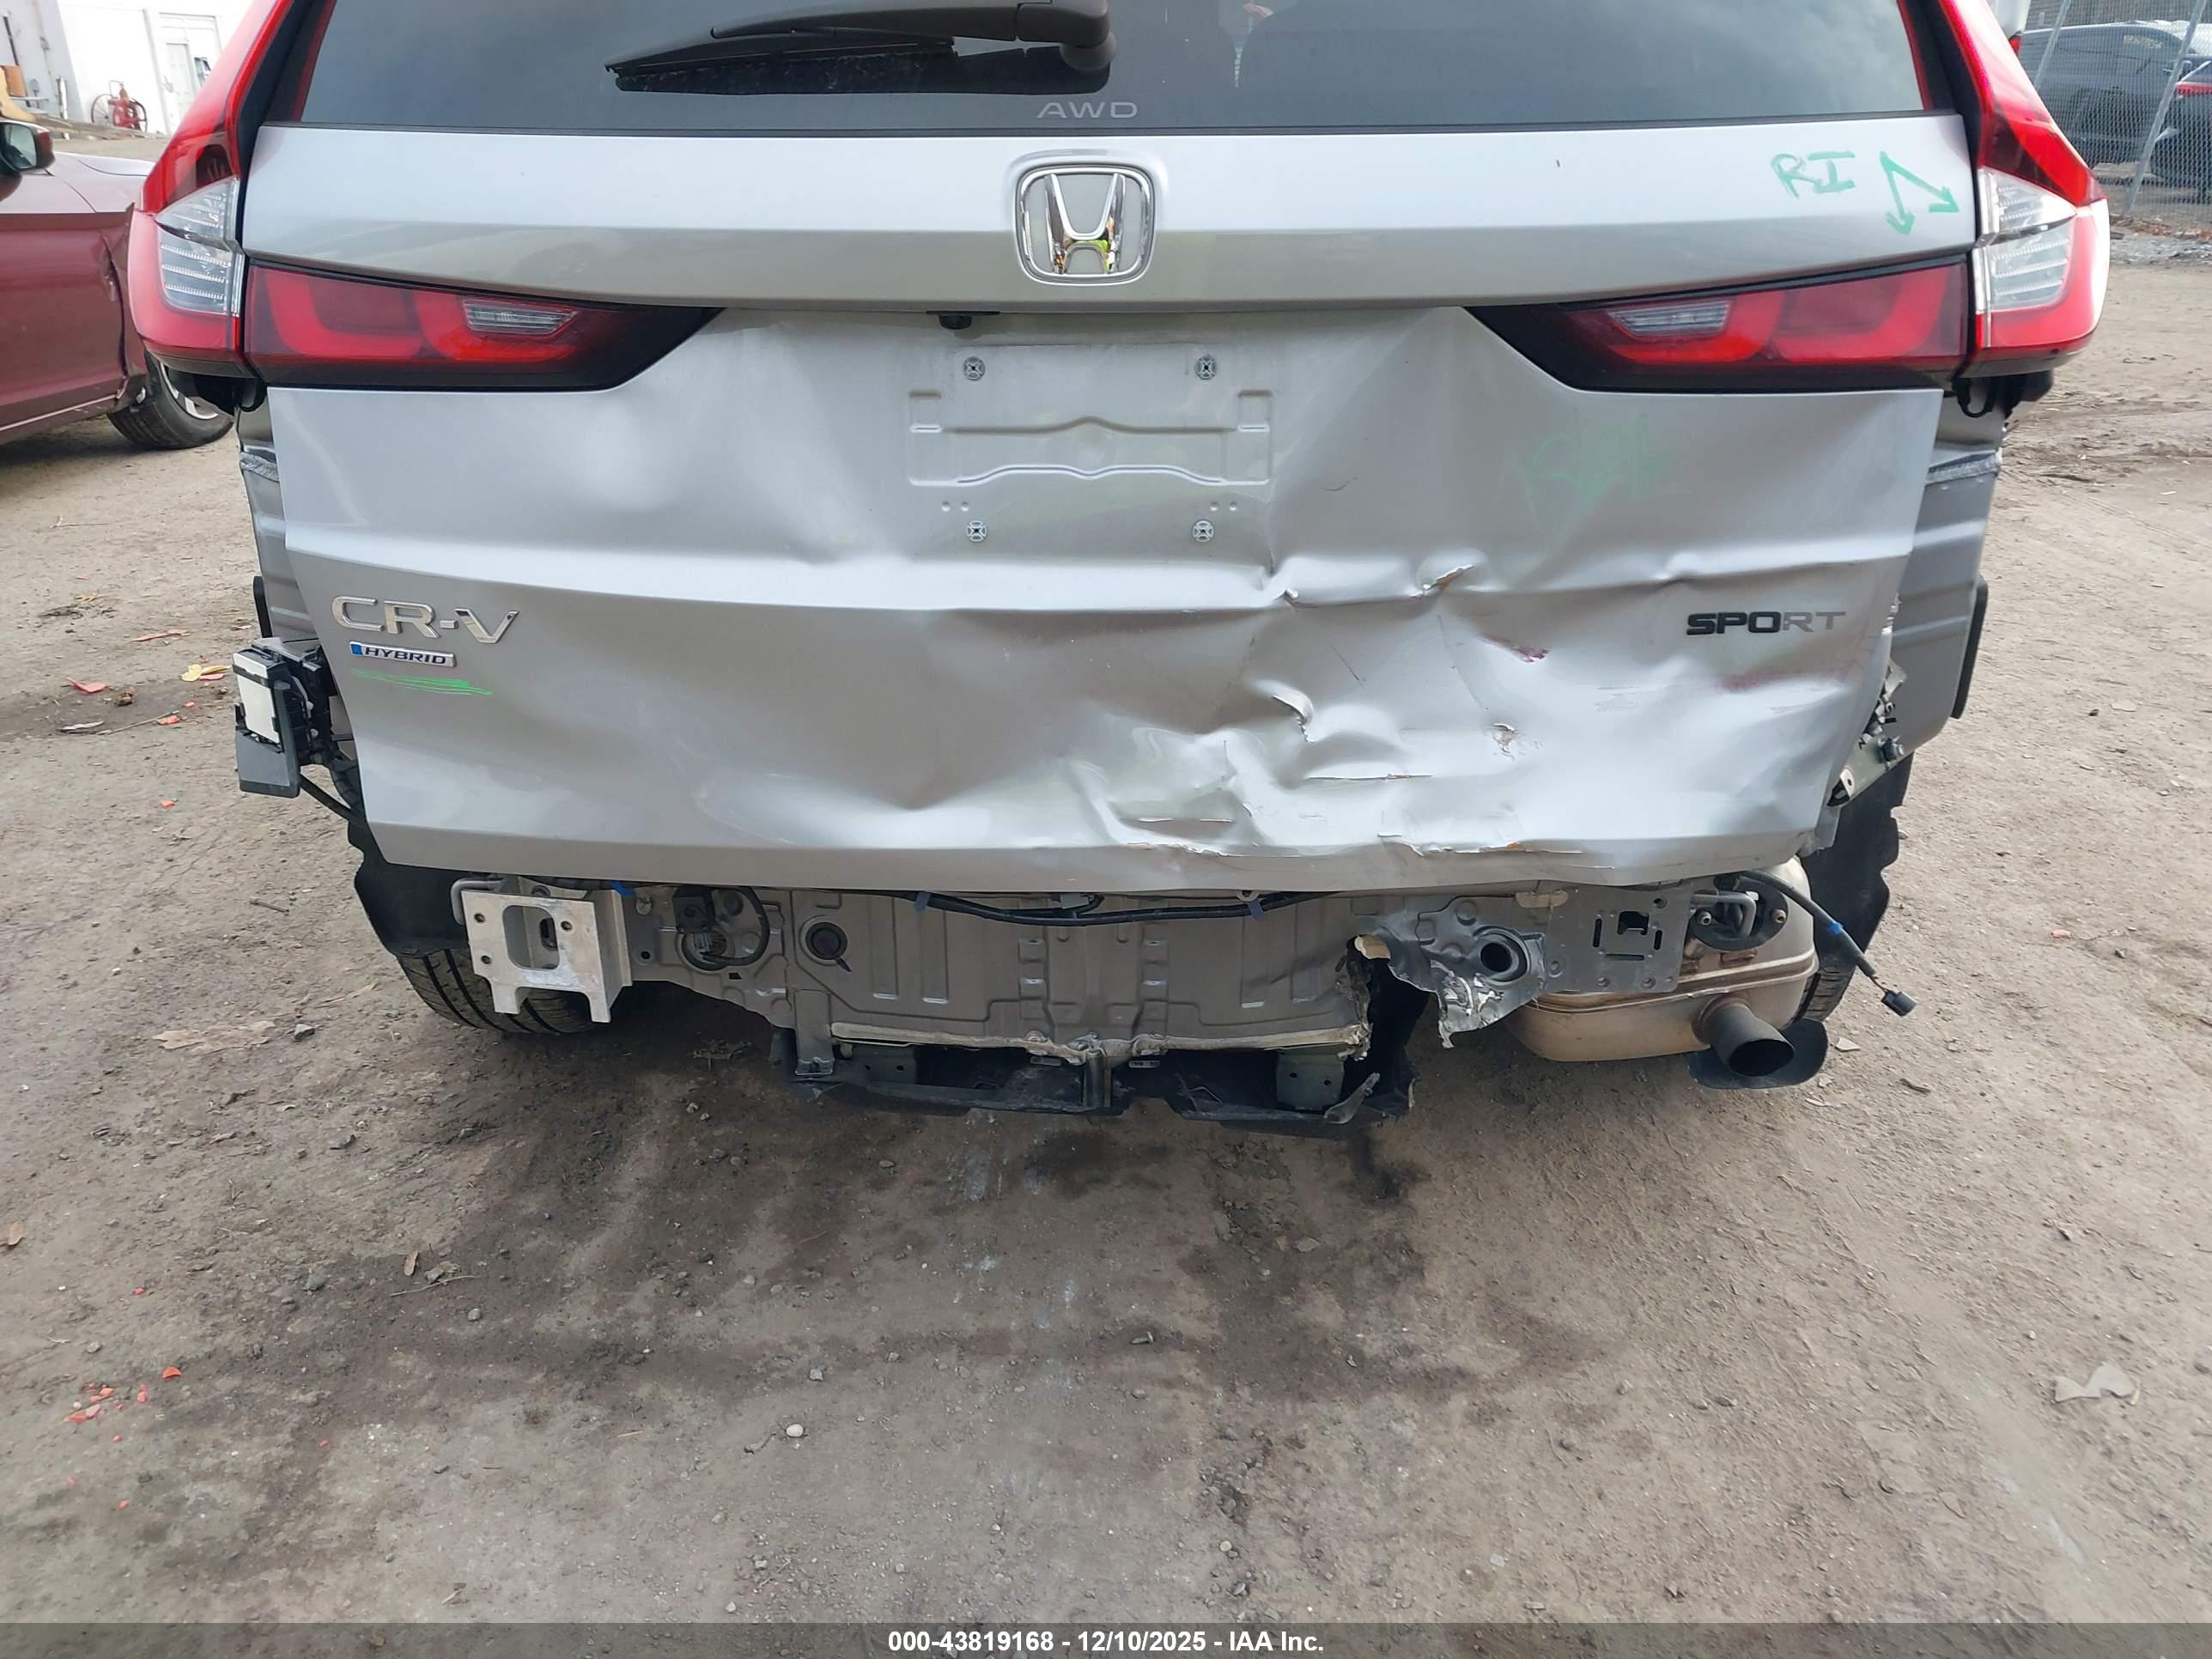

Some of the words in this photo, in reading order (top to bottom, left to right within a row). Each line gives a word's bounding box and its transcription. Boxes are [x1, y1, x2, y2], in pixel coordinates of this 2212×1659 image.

[1036, 101, 1139, 118] AWD
[331, 595, 520, 644] CR-V
[1686, 611, 1846, 635] SPORT
[365, 647, 447, 665] HYBRID
